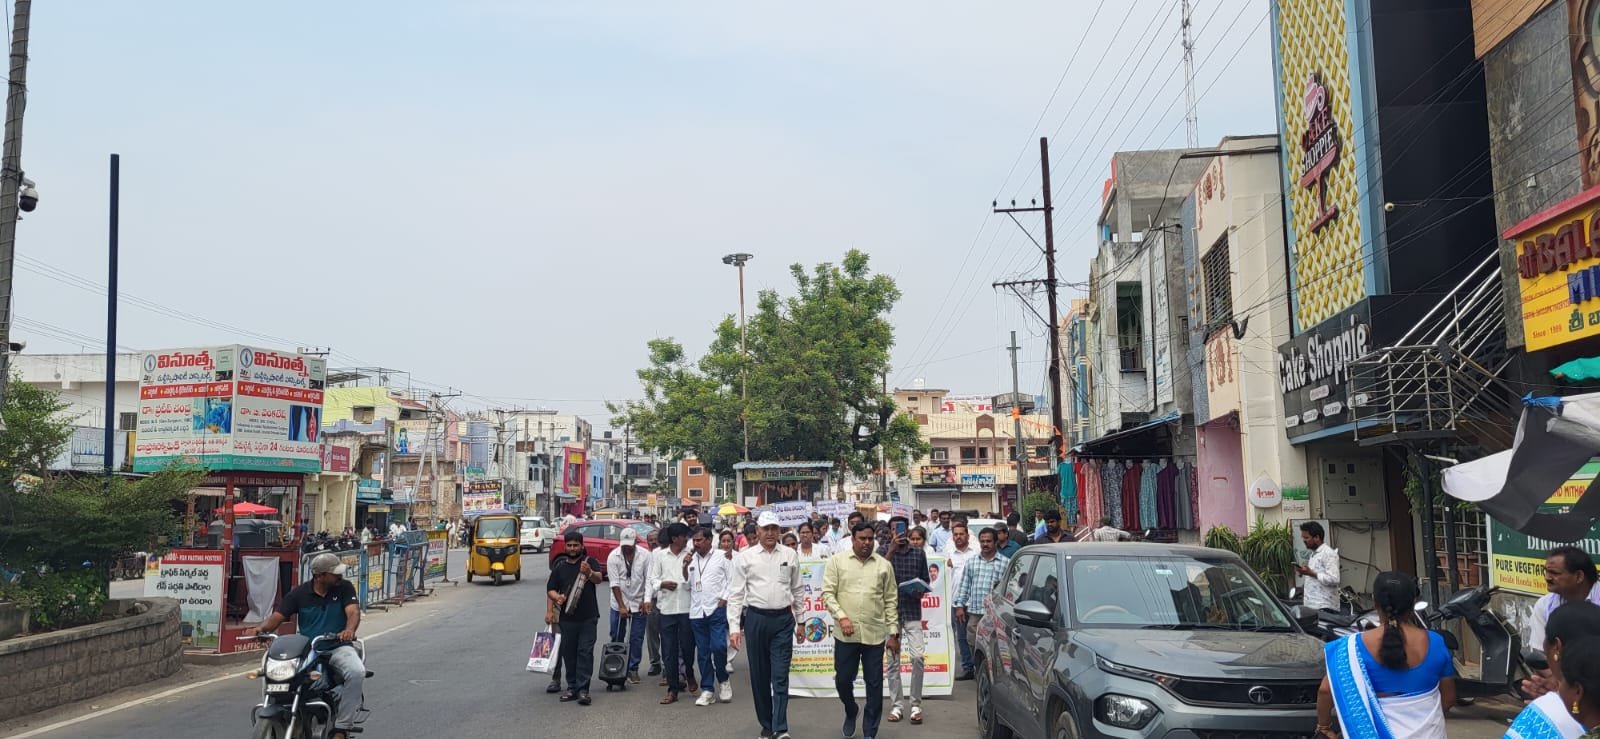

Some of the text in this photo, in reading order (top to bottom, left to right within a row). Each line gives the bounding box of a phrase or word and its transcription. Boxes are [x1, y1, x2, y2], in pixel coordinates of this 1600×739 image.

[1300, 128, 1334, 176] SHOPPIE
[157, 351, 215, 371] వినూత్న
[254, 352, 309, 377] వినూత్న
[1278, 314, 1368, 395] Cake Shoppie
[270, 442, 278, 451] 24
[1496, 559, 1512, 572] PURE
